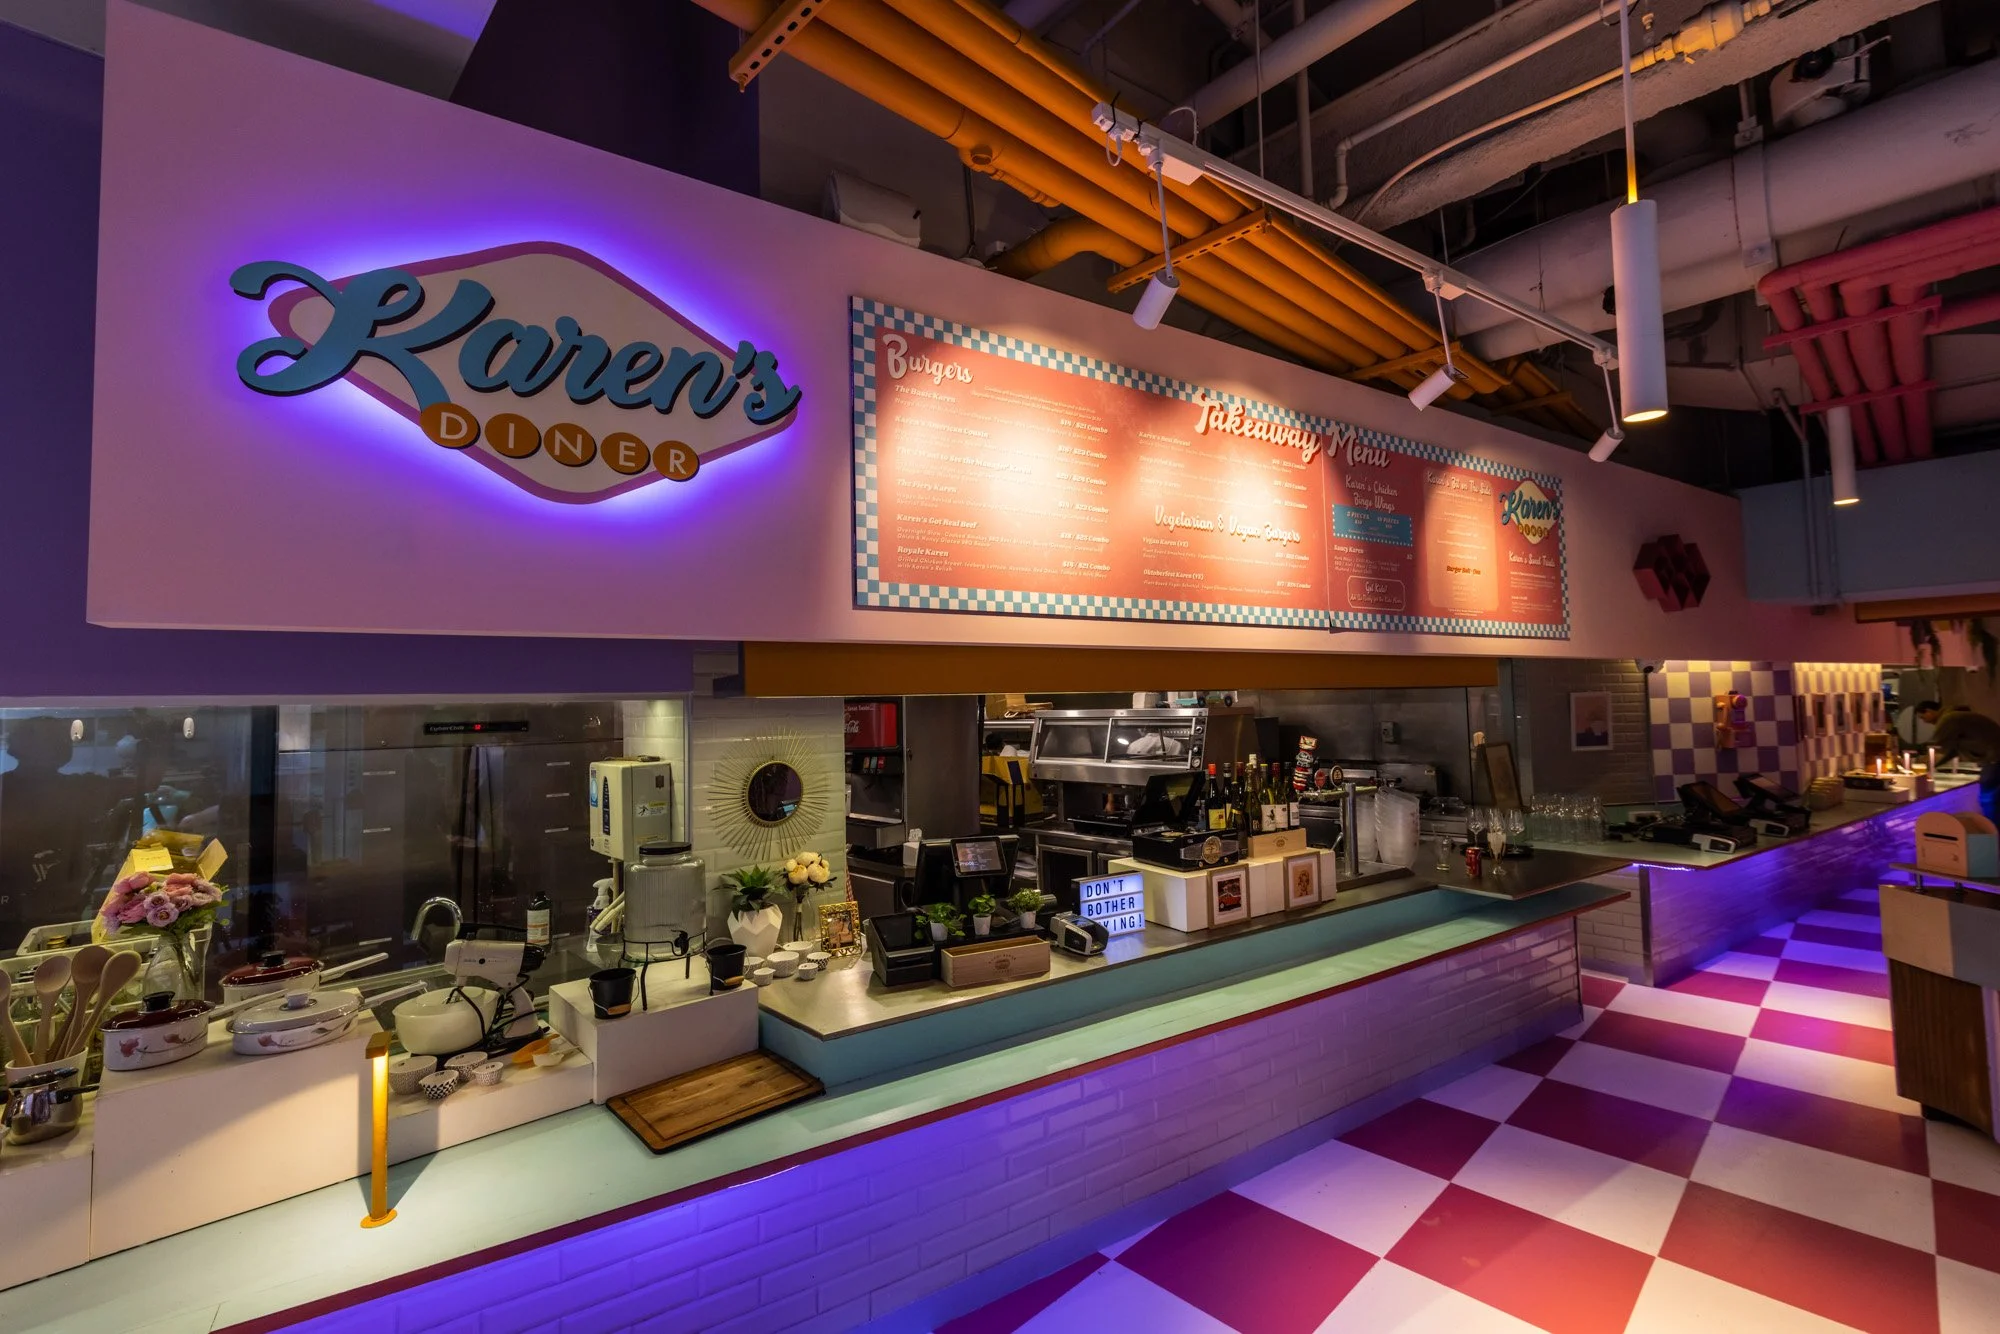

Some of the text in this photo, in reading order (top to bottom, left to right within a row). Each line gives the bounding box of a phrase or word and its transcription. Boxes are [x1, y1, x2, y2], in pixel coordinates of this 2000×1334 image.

[229, 260, 802, 426] Karen's
[883, 334, 974, 385] Burgers
[895, 385, 956, 403] The Basic Karen
[1087, 424, 1108, 434] Combo
[1194, 387, 1321, 464] Takeaway
[1326, 421, 1391, 468] Menu
[439, 410, 687, 476] DINER
[1346, 474, 1398, 497] Karen's Chicken
[1427, 470, 1449, 487] Karen's
[1374, 496, 1395, 514] Wings
[1499, 490, 1560, 526] Karen's
[897, 514, 978, 529] Karen's Got Real Beef
[1154, 504, 1301, 547] Vegetarian & Vegan Burgers
[1088, 535, 1110, 544] Combo
[898, 545, 949, 557] Royale Karen
[1349, 546, 1364, 554] Karen
[1509, 551, 1527, 564] Karen's
[1529, 553, 1541, 565] Sweet
[1089, 563, 1110, 571] Combo
[1144, 569, 1175, 577] Oktoberfest
[1446, 565, 1462, 573] Burger
[1086, 880, 1124, 897] DON'T
[1088, 897, 1135, 917] BOTHER
[1099, 914, 1141, 931] YING!
